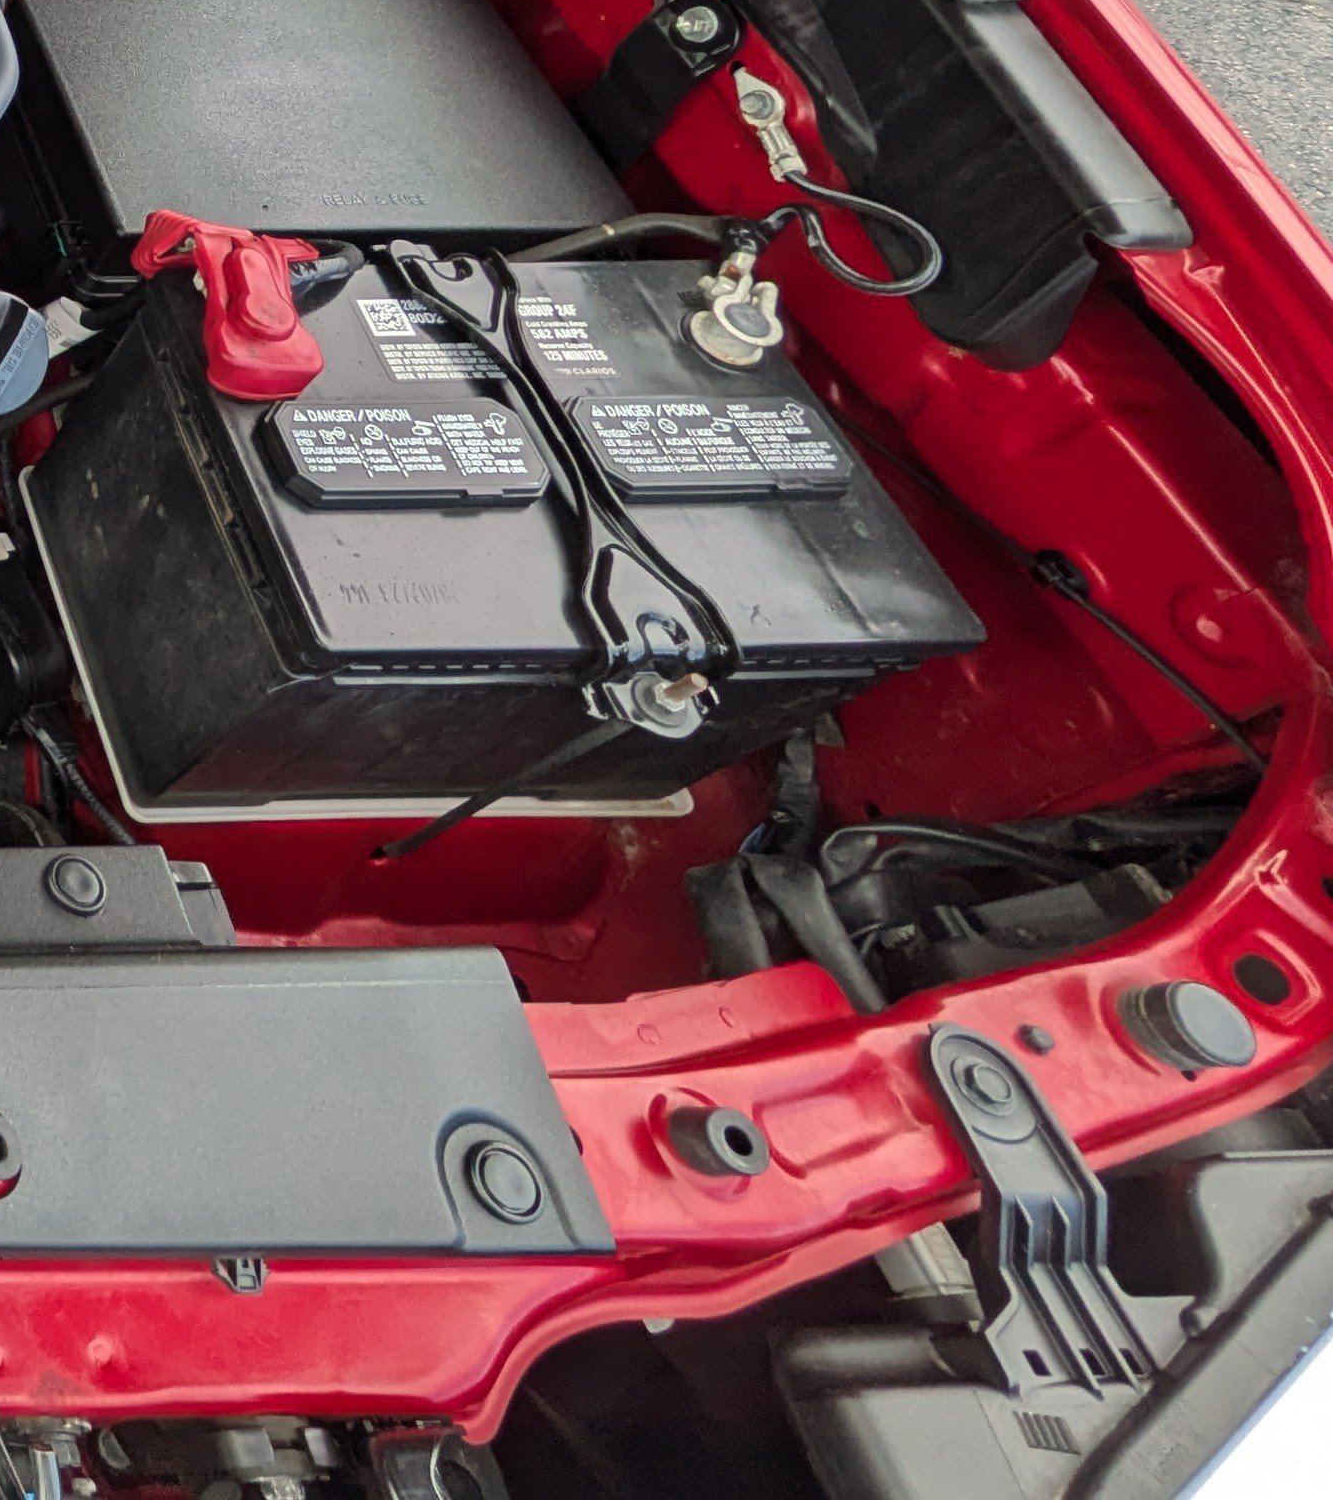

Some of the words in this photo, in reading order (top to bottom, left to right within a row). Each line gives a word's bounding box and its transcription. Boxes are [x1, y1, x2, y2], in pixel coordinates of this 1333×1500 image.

[321, 193, 368, 206] RELAY
[388, 193, 428, 206] FUSE
[518, 304, 554, 317] GROUP
[530, 328, 554, 340] 582
[554, 328, 589, 340] AMPS
[542, 350, 563, 362] 125
[561, 350, 609, 362] MINUTES
[572, 367, 617, 376] CLARIOS
[306, 409, 357, 423] DANGER
[357, 409, 364, 422] /
[364, 408, 412, 422] POISON
[604, 404, 656, 418] DANGER
[662, 403, 711, 417] POISON
